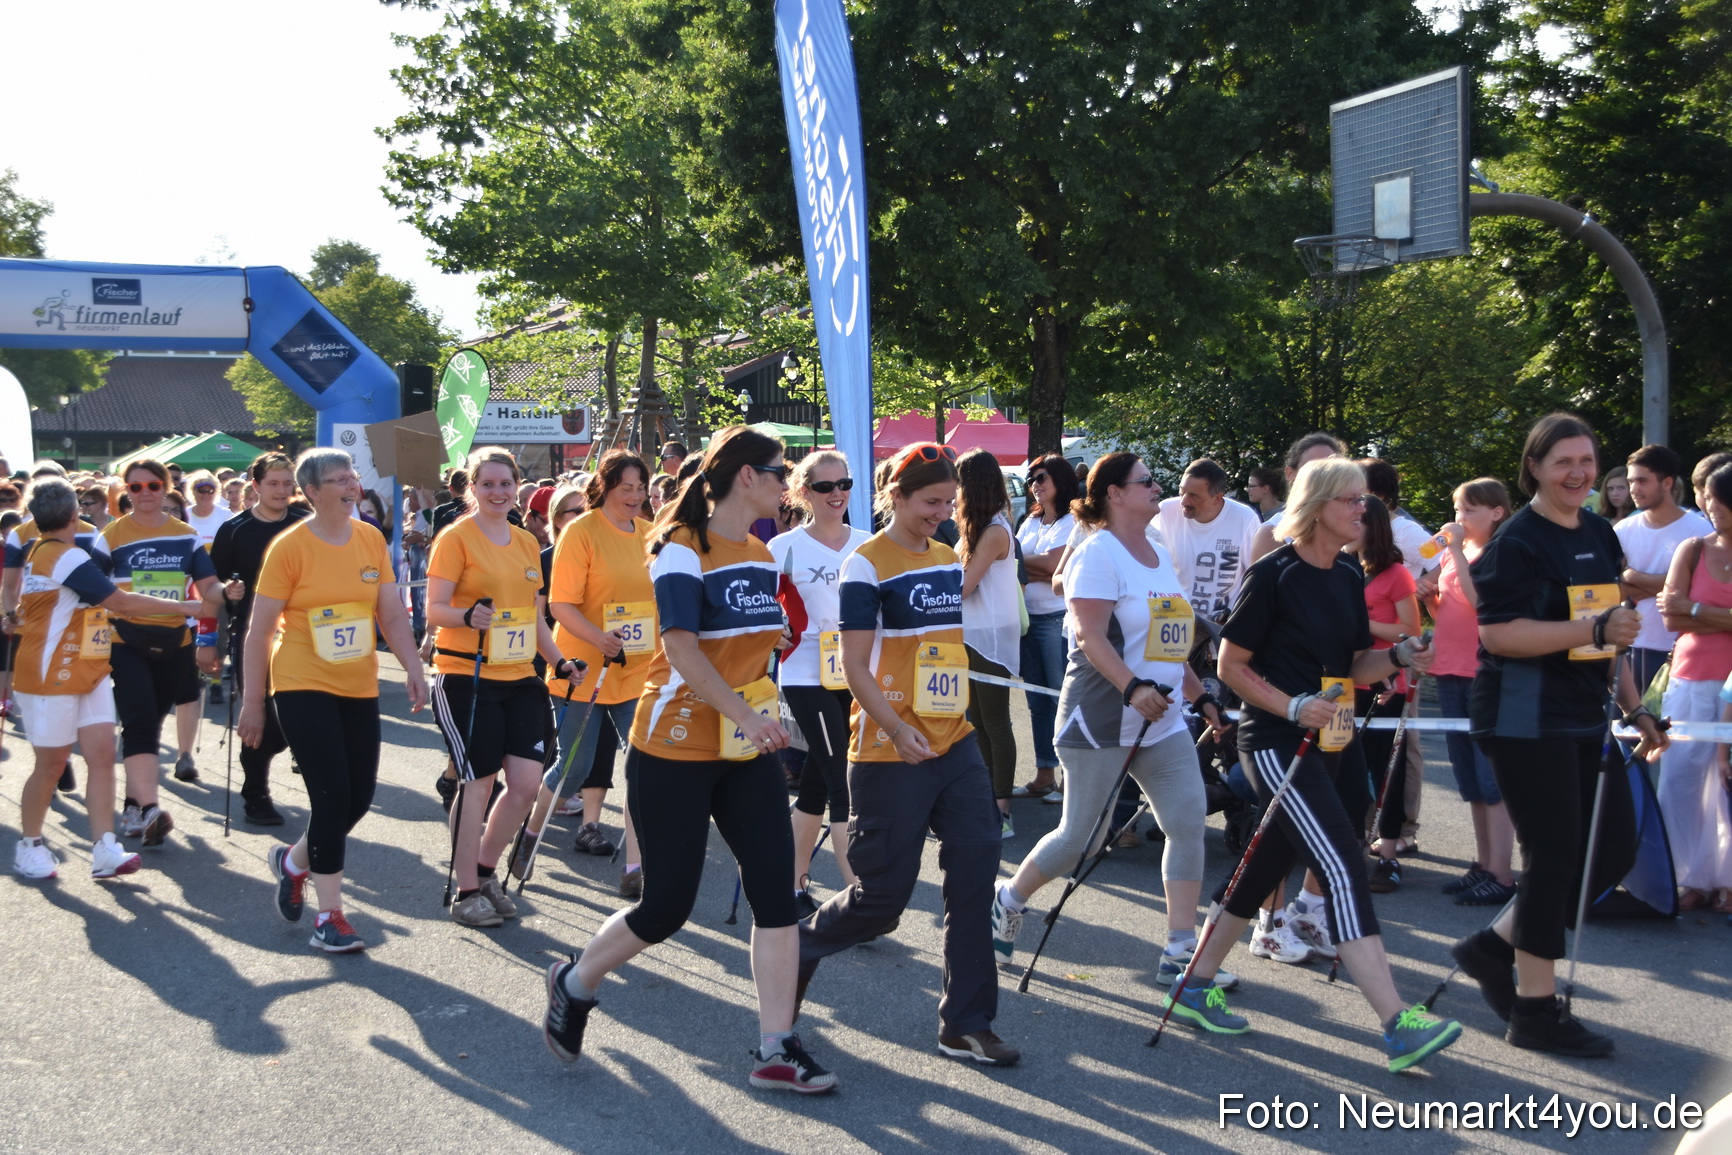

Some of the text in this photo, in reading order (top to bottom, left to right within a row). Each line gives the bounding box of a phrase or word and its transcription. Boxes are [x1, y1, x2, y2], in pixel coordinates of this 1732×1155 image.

[103, 288, 139, 297] Fischer
[76, 305, 183, 326] firmenlauf
[139, 555, 183, 565] Fischer
[807, 565, 840, 586] Xpl
[334, 626, 356, 647] 57
[507, 630, 525, 649] 71
[622, 623, 642, 641] 65
[1160, 623, 1187, 644] 601
[927, 672, 958, 697] 401
